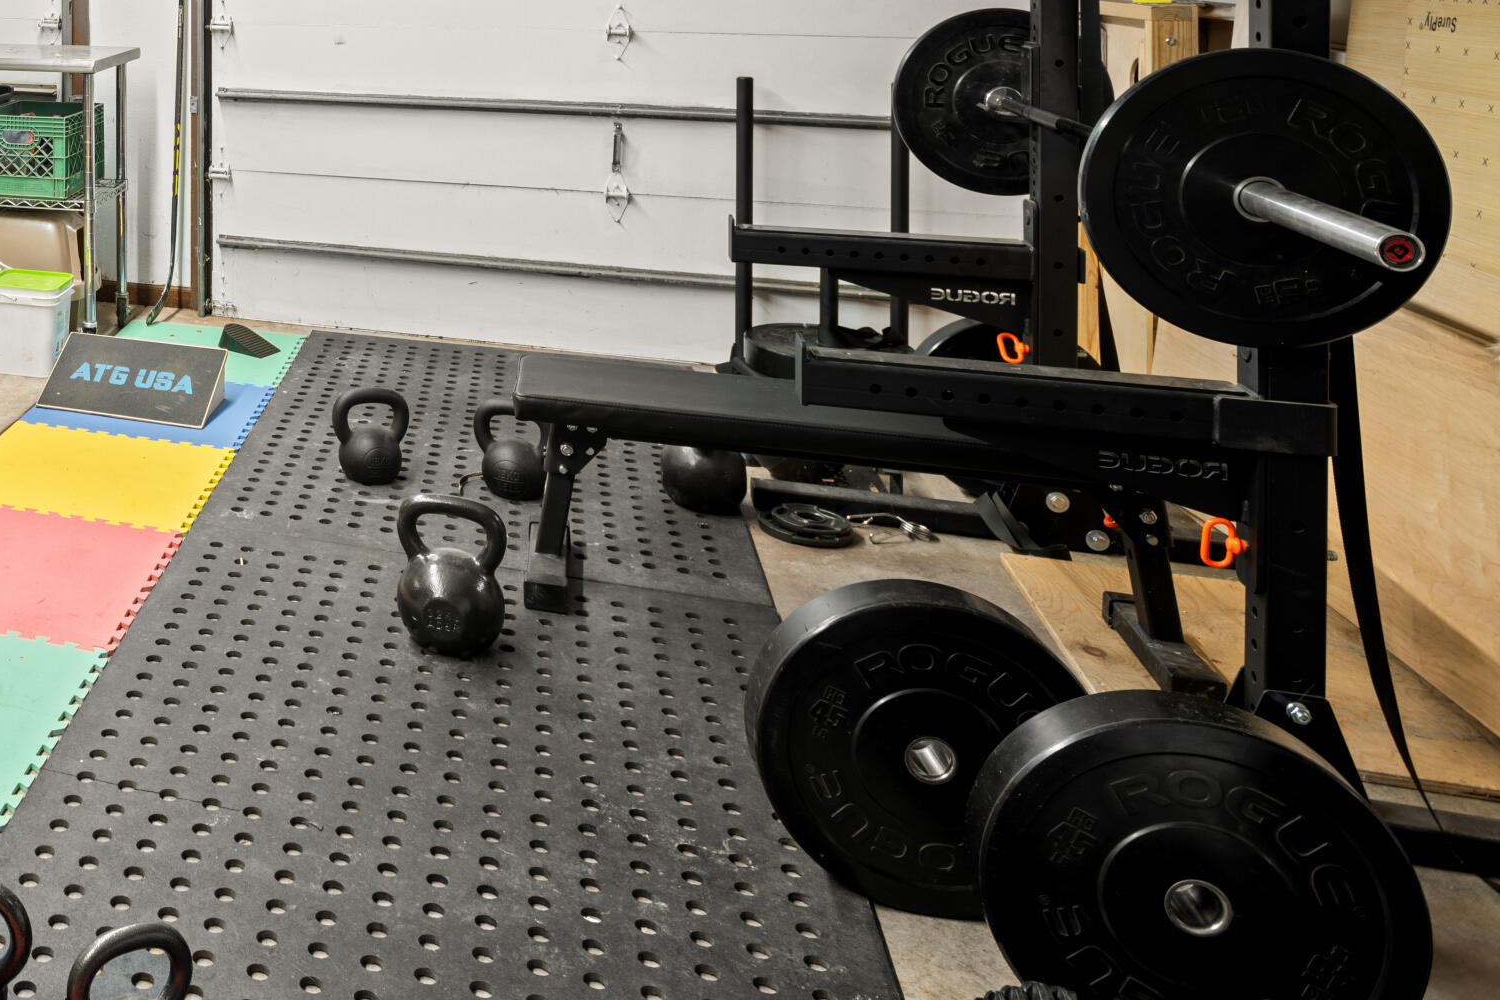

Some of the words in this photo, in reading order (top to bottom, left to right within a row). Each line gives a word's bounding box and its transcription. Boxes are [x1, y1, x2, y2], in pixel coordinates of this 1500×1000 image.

[1424, 11, 1457, 33] SurePly
[924, 34, 1025, 109] ROGUE
[69, 361, 130, 386] ATG
[134, 367, 193, 395] USA
[853, 643, 1041, 726] ROGU
[807, 769, 965, 872] OGUE
[1108, 769, 1356, 909] ROGUE
